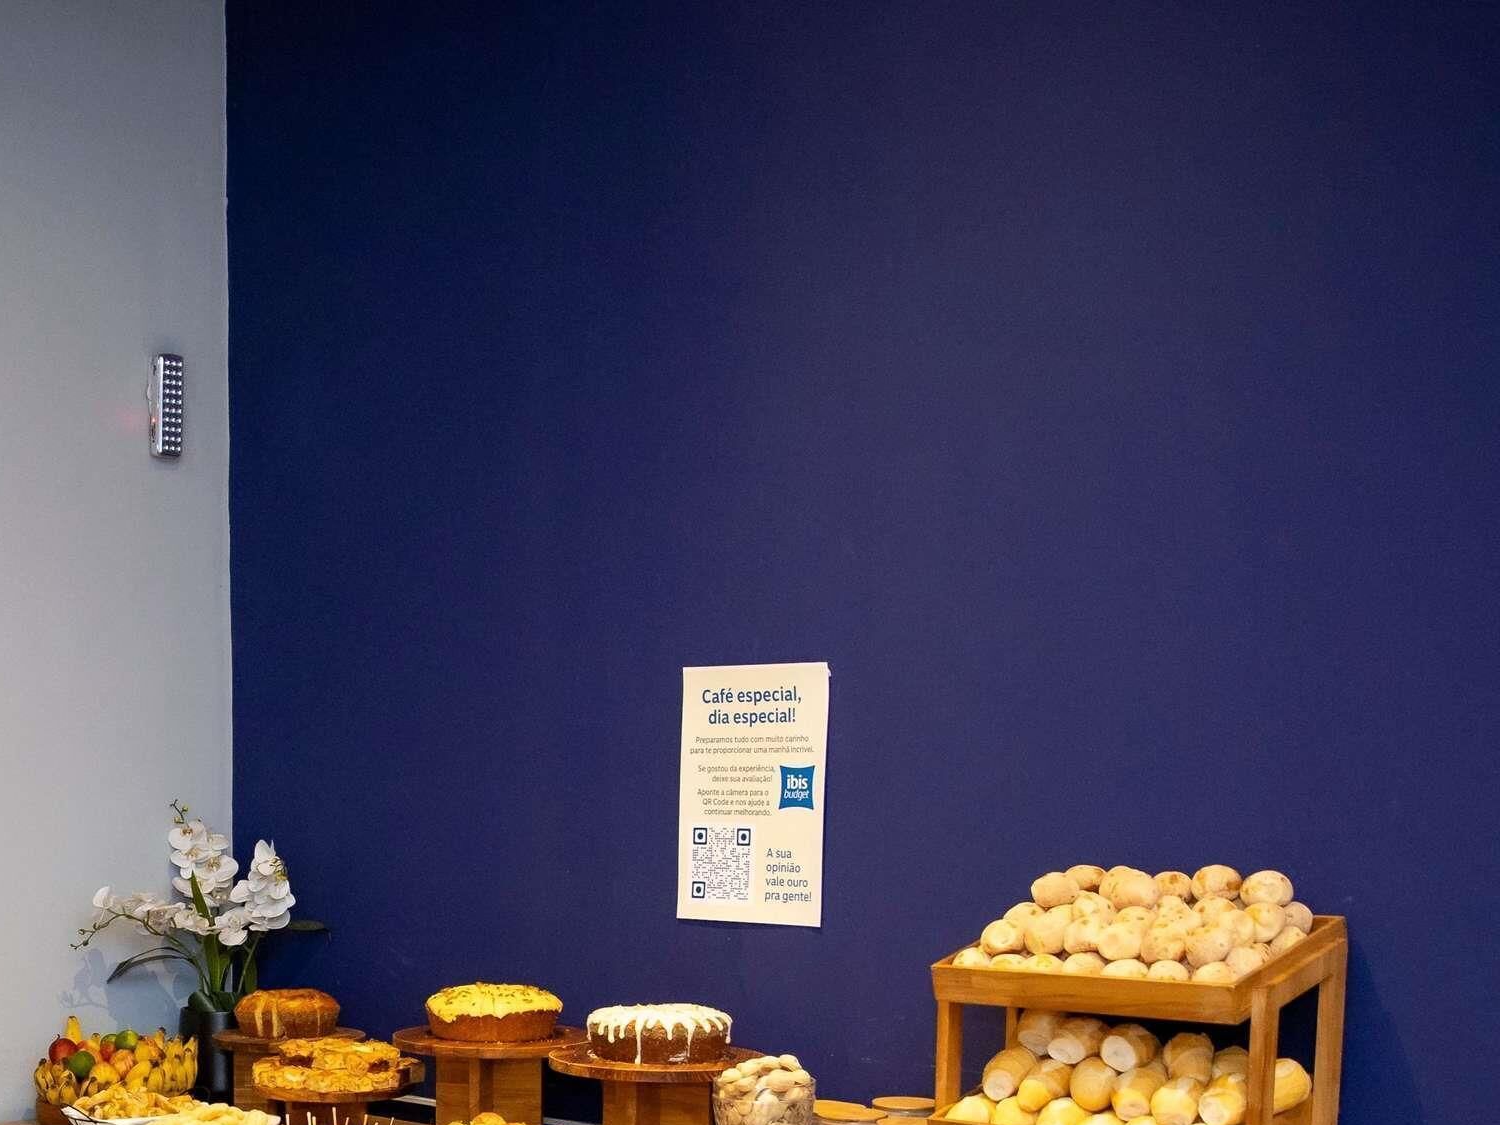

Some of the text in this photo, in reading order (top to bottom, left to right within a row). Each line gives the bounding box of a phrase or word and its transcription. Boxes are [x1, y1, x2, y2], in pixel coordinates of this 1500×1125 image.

[702, 686, 801, 706] Café especial,
[709, 708, 796, 727] dia especial!
[713, 746, 752, 754] proporcionar
[769, 745, 790, 753] manhã
[787, 775, 807, 789] ibis
[784, 790, 809, 801] budget
[767, 849, 791, 858] A sua
[766, 862, 801, 873] opinião
[766, 877, 808, 887] vale ouro
[765, 892, 812, 903] pra gente!
